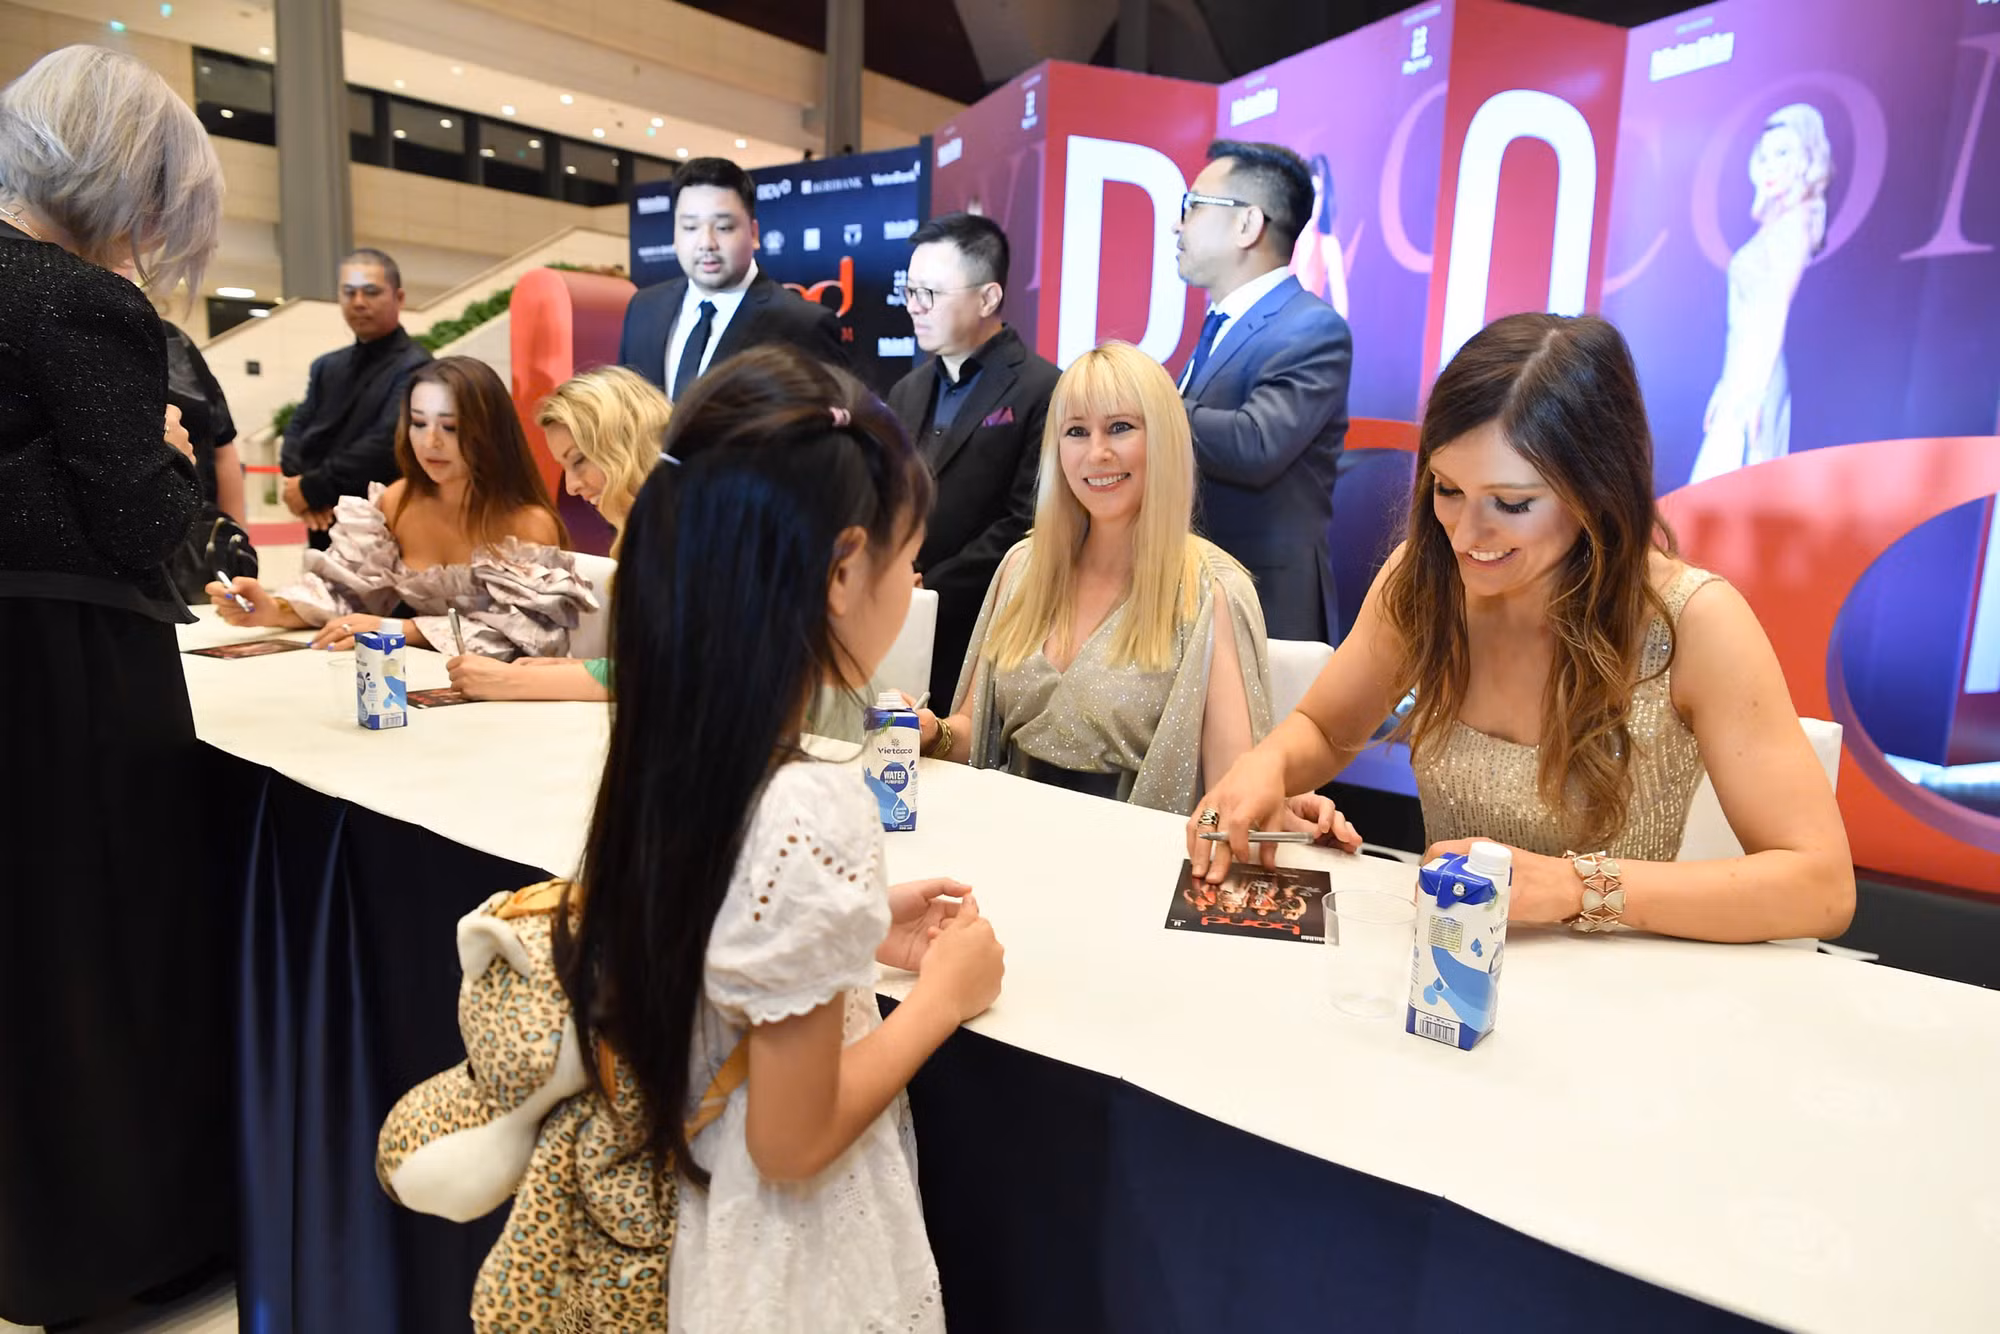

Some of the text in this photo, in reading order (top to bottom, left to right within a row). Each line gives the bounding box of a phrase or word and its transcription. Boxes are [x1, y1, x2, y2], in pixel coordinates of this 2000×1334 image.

[1057, 135, 1188, 371] D
[883, 771, 906, 780] WATER
[1201, 916, 1301, 936] bond
